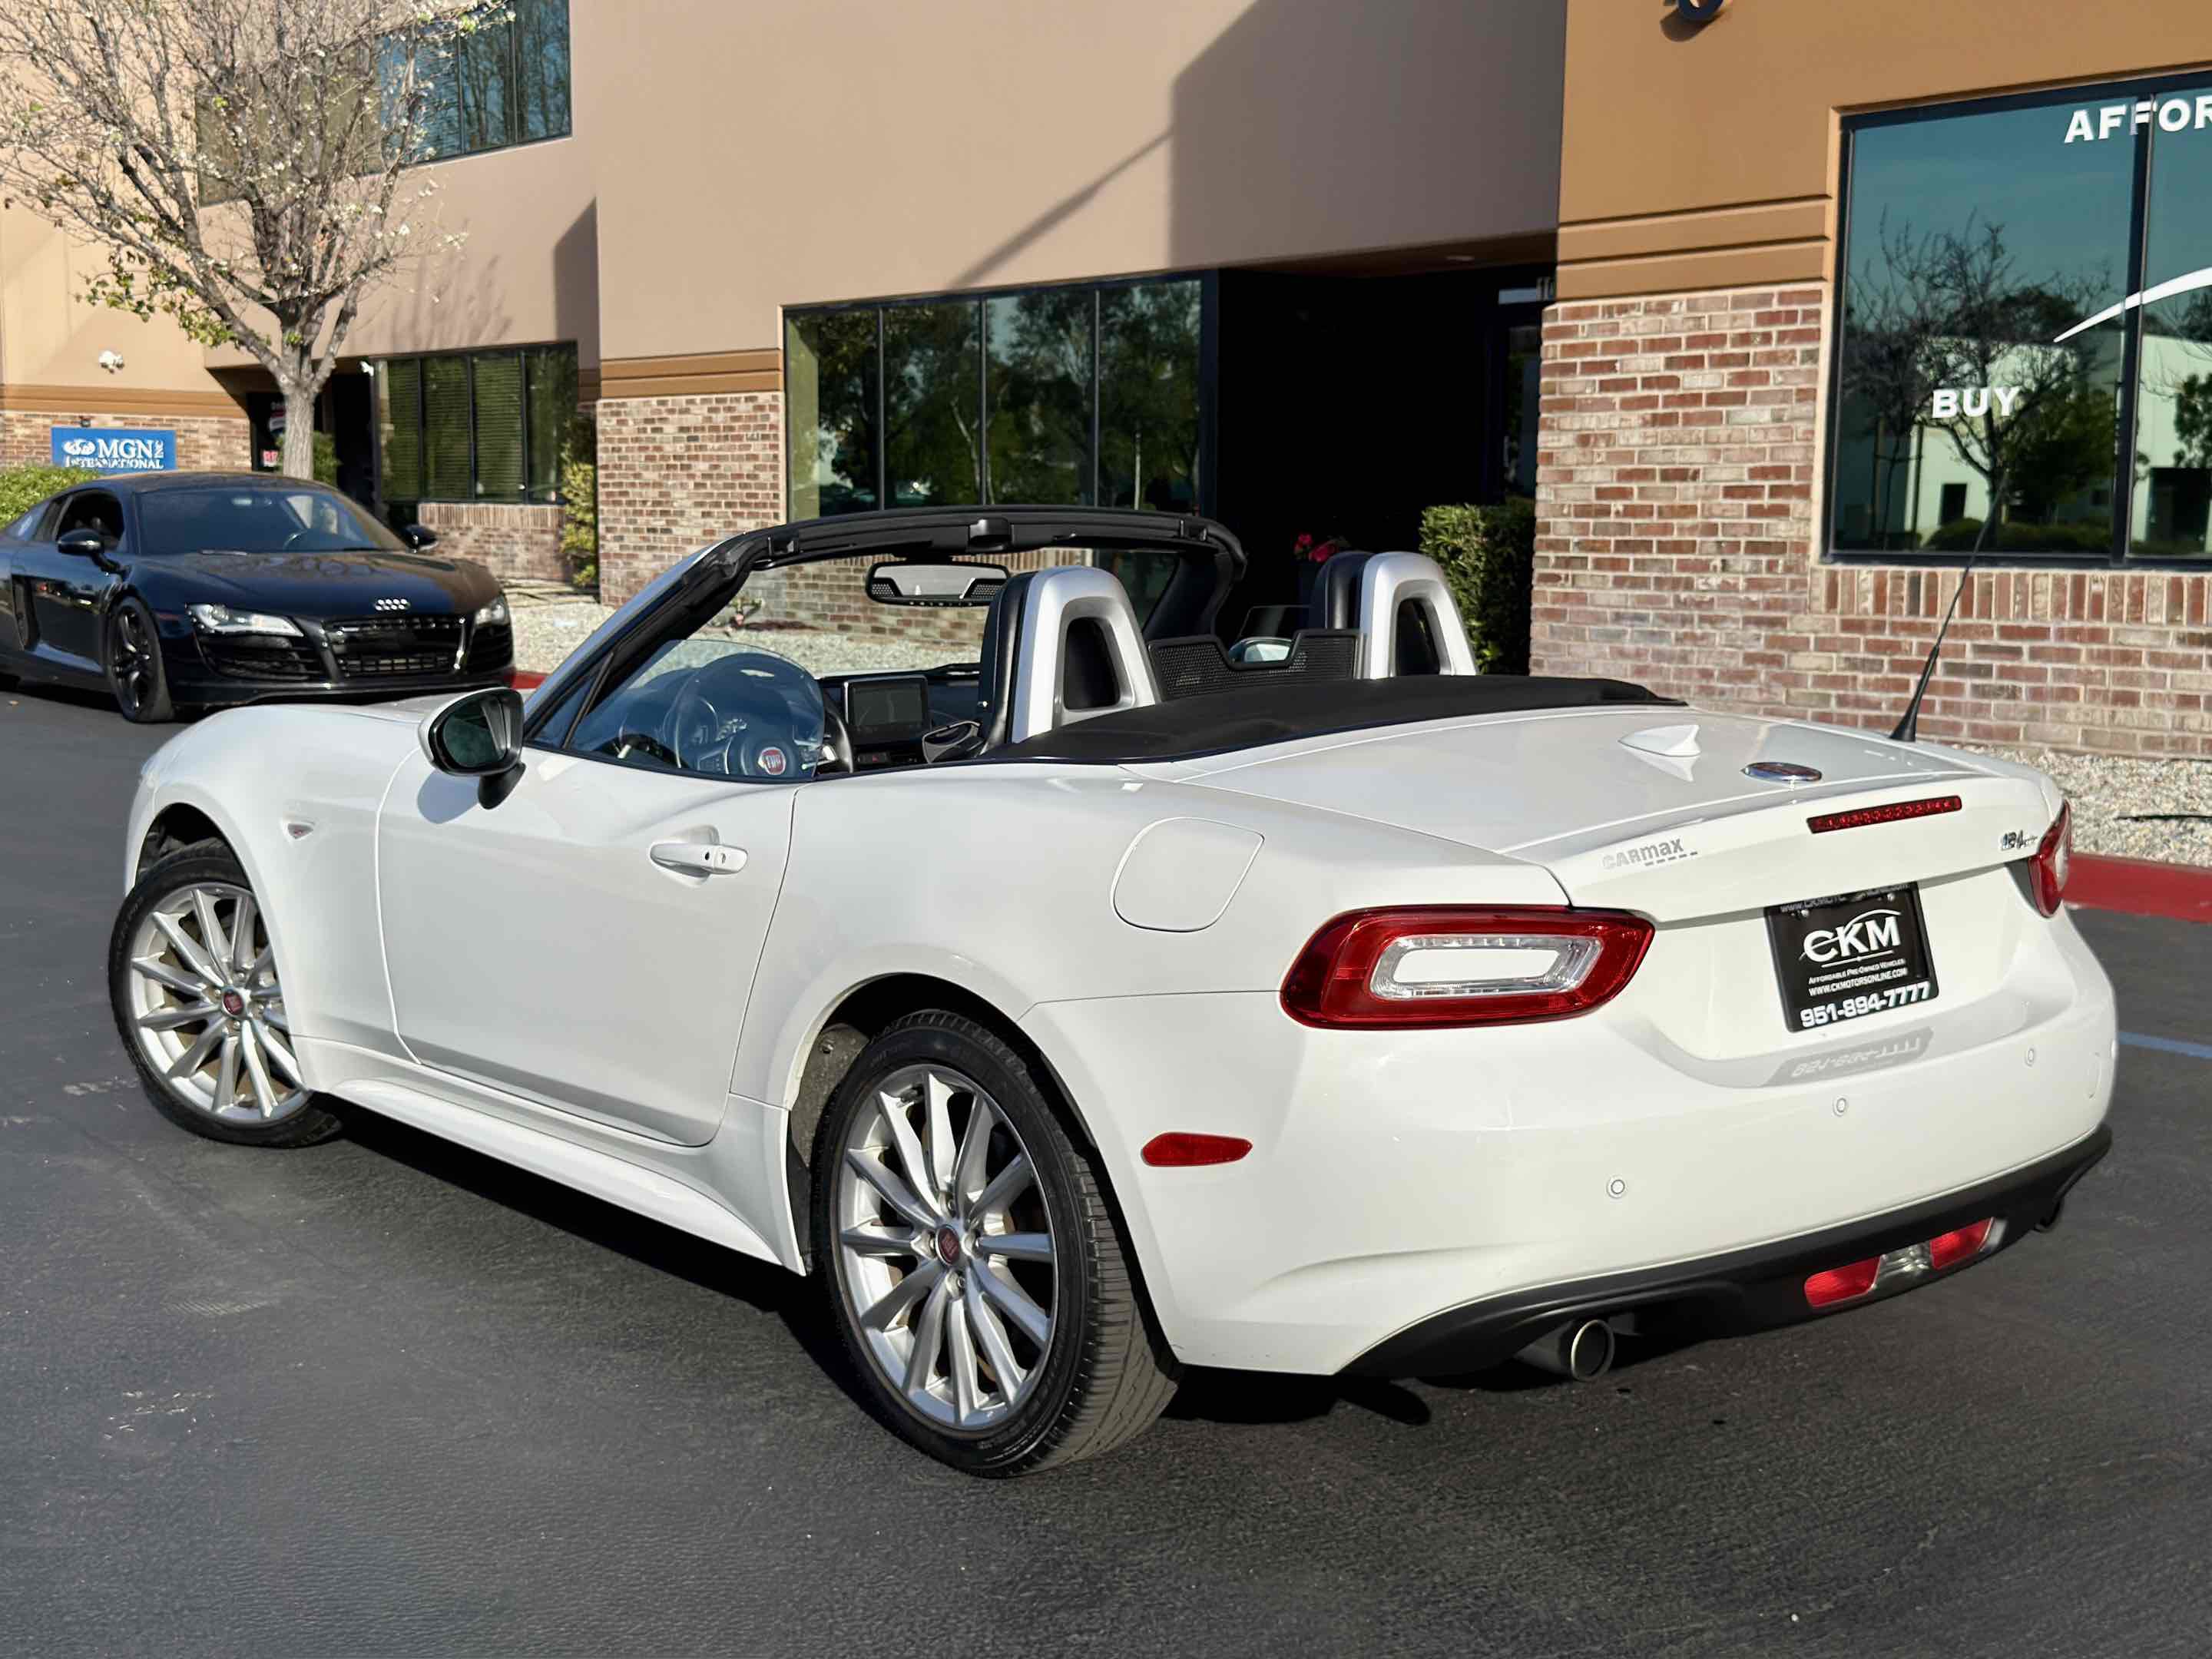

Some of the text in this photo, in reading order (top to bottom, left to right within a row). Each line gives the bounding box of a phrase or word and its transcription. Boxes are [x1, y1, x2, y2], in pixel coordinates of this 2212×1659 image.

[1932, 386, 2022, 419] BUY
[97, 439, 153, 459] MGN
[1800, 980, 1930, 1028] 951-894-7777
